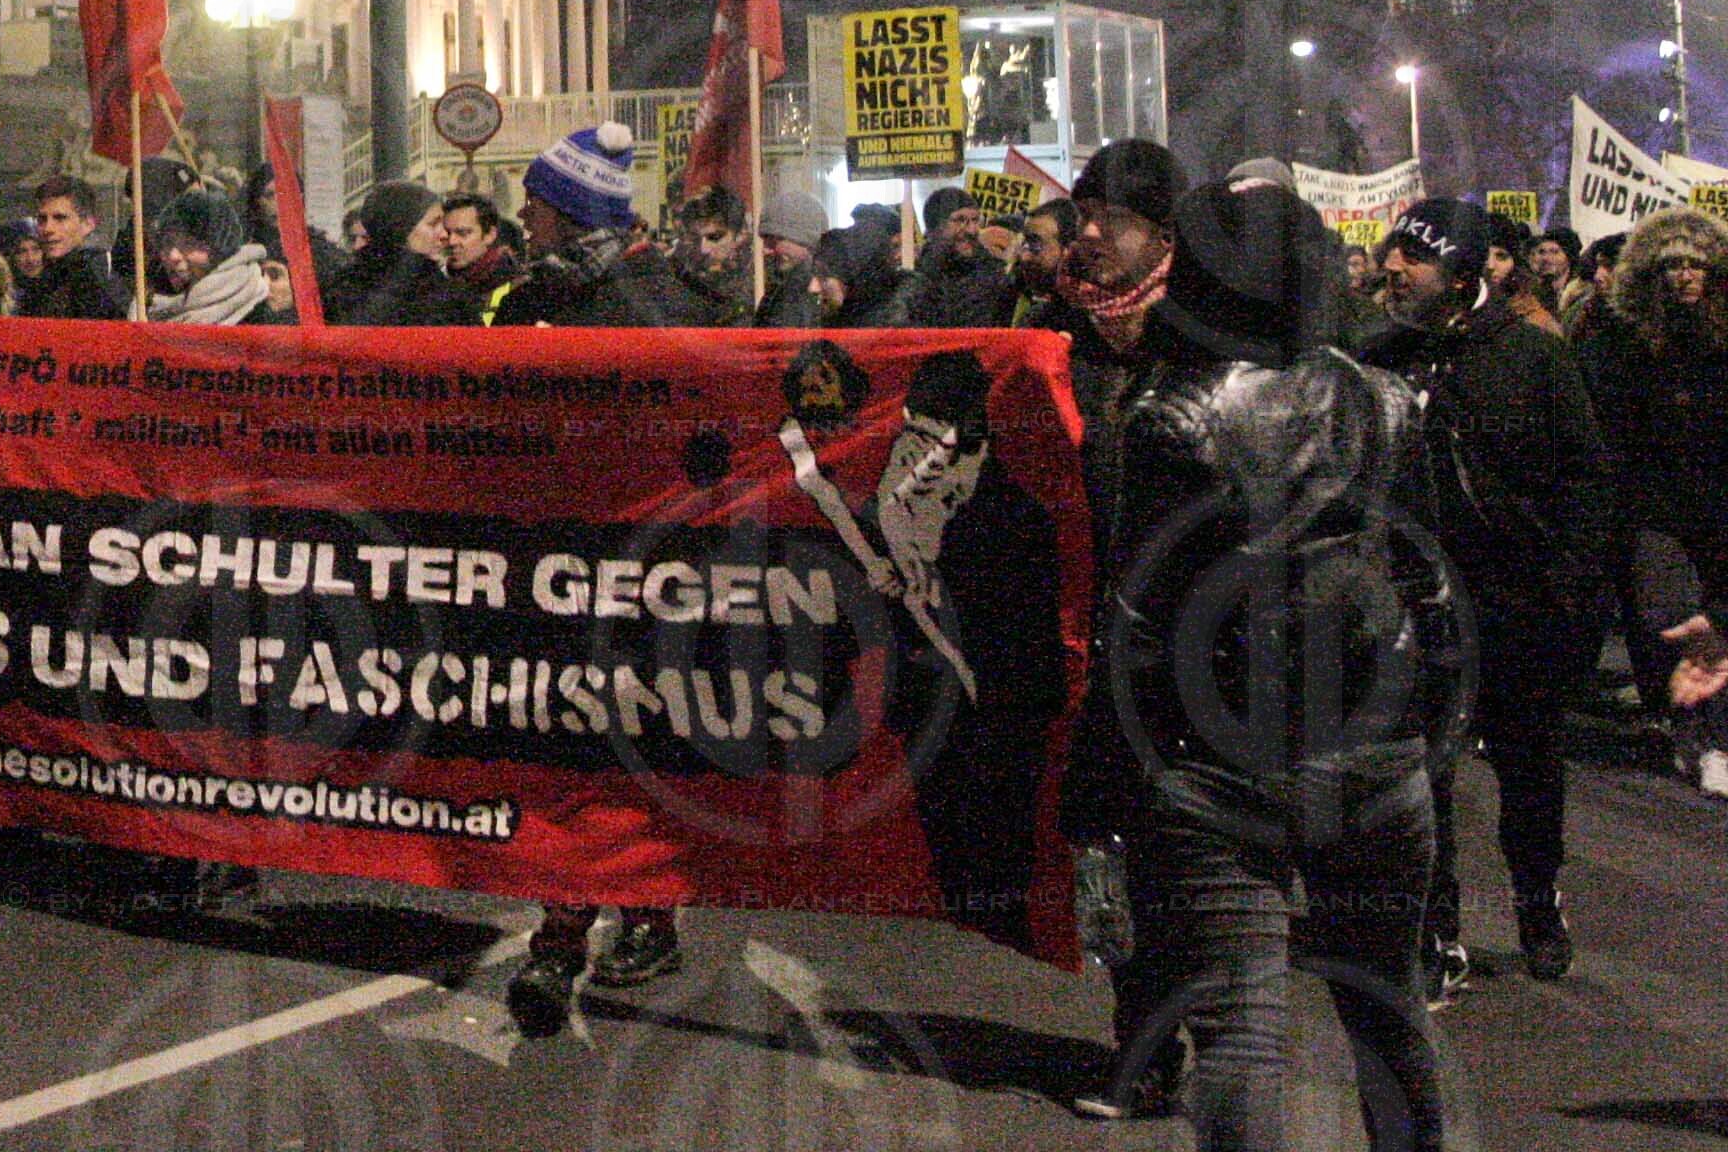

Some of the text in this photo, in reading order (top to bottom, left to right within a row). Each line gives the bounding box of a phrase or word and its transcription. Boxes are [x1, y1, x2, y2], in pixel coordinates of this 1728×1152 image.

[854, 14, 947, 48] LASST
[855, 46, 949, 78] NAZIS
[856, 77, 949, 110] NICHT
[664, 107, 697, 132] LAS
[857, 108, 951, 131] REGIEREN
[858, 134, 953, 154] UND NIEMALS
[972, 171, 1034, 198] LASST
[1581, 173, 1629, 216] UND
[68, 357, 132, 388] und
[88, 528, 509, 611] SCHULTER
[532, 553, 839, 627] GEGEN
[29, 625, 211, 703] UND
[238, 636, 826, 741] FASCHISMUS
